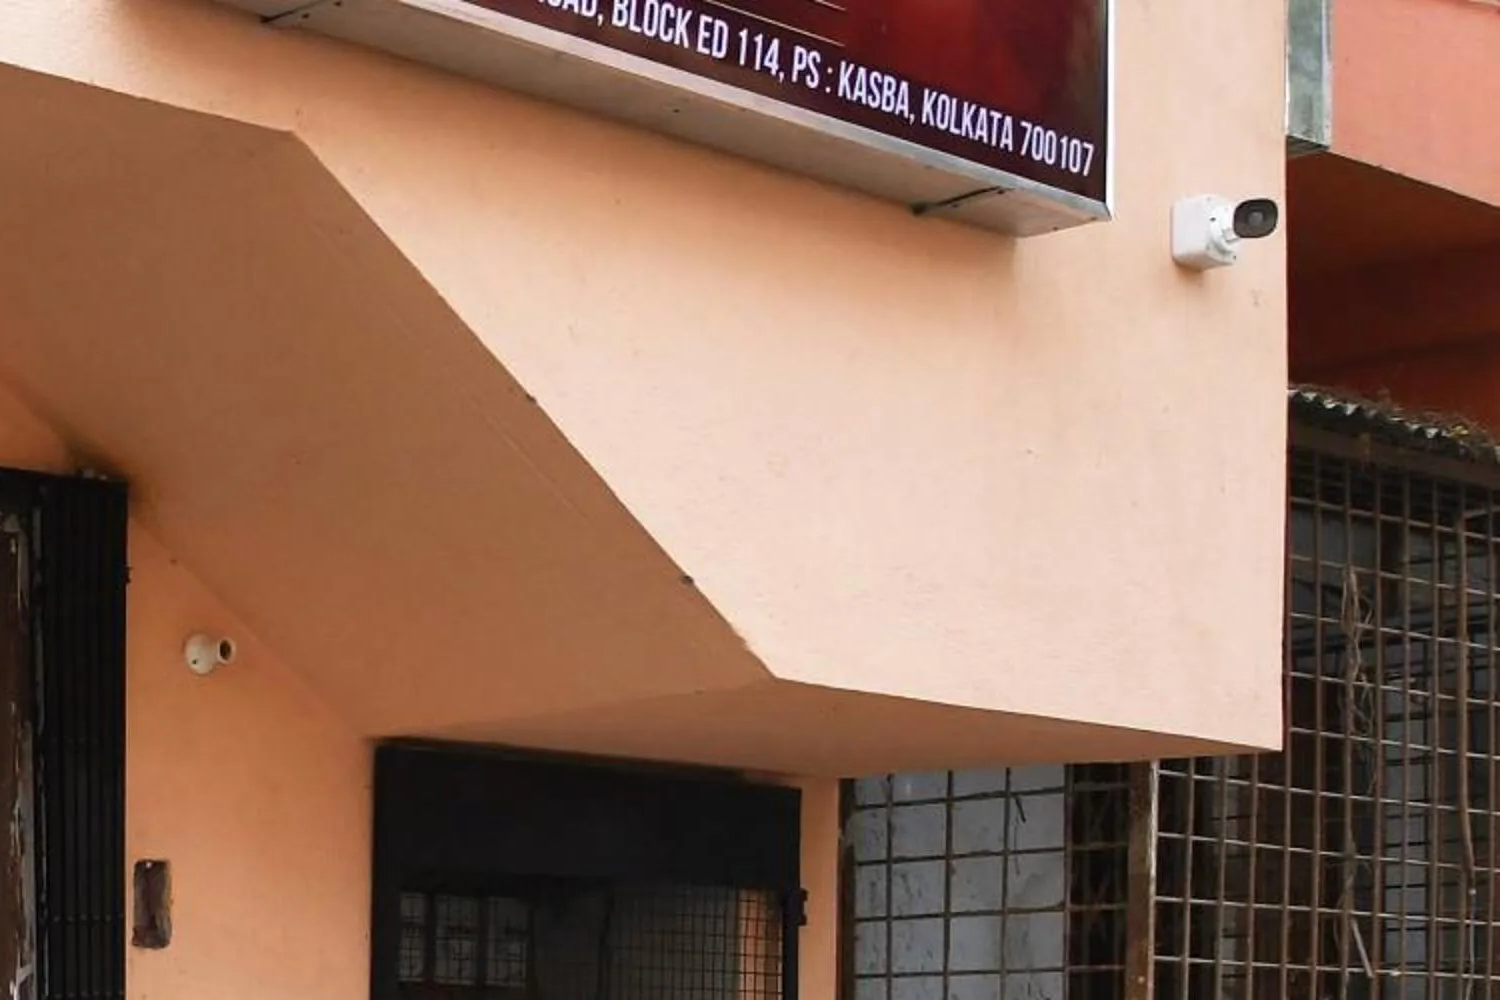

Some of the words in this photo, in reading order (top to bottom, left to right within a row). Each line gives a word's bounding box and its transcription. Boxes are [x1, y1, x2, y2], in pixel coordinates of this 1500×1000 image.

[612, 0, 693, 48] BLOCK
[697, 15, 729, 59] ED
[738, 28, 785, 83] 114,
[791, 45, 821, 89] PS
[837, 60, 915, 126] KASBA,
[921, 88, 1013, 152] KOLKATA
[1019, 121, 1095, 177] 700107
